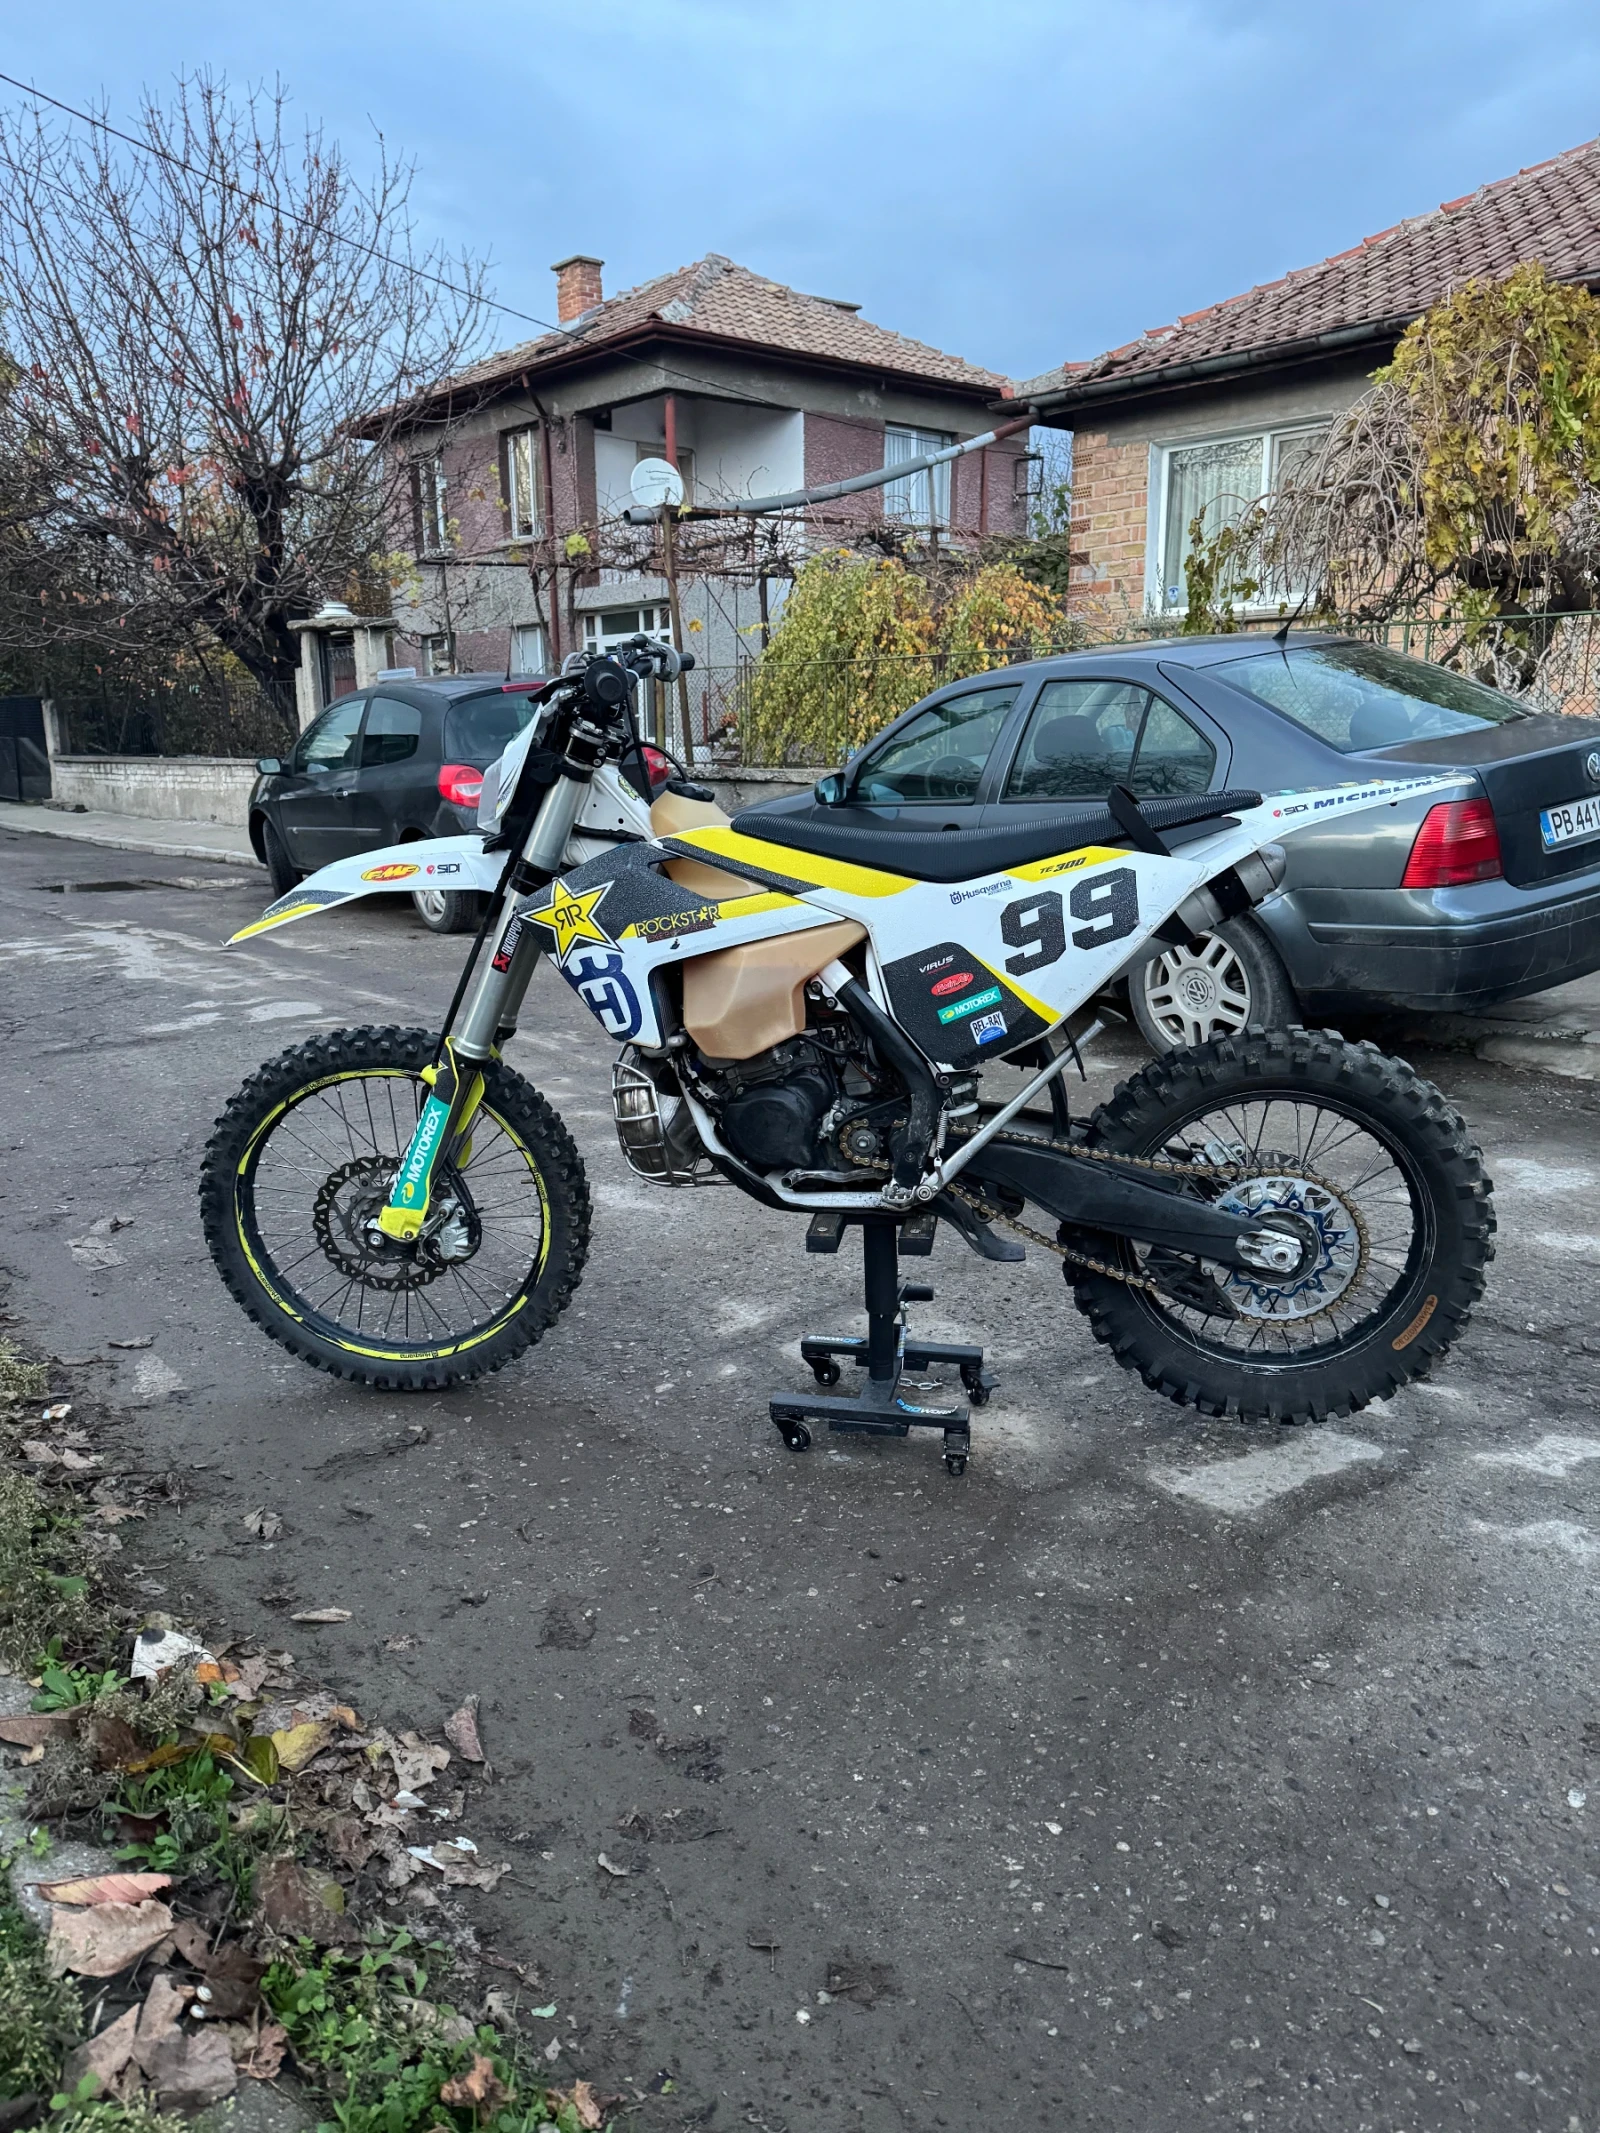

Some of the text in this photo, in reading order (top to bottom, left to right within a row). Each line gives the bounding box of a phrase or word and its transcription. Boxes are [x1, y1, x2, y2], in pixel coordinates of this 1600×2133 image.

[1314, 780, 1432, 810] MICHELIN
[1551, 799, 1600, 838] PB 441
[365, 865, 417, 880] FMF
[437, 863, 461, 874] SIDI
[1040, 857, 1087, 875] TE 300
[961, 879, 1012, 901] Husqvarna
[1000, 867, 1139, 977] 99
[919, 954, 954, 973] VIRUS
[954, 990, 998, 1015] MOTOREX
[972, 1012, 1003, 1037] BEL-RAY
[406, 1105, 443, 1183] MOTOREX
